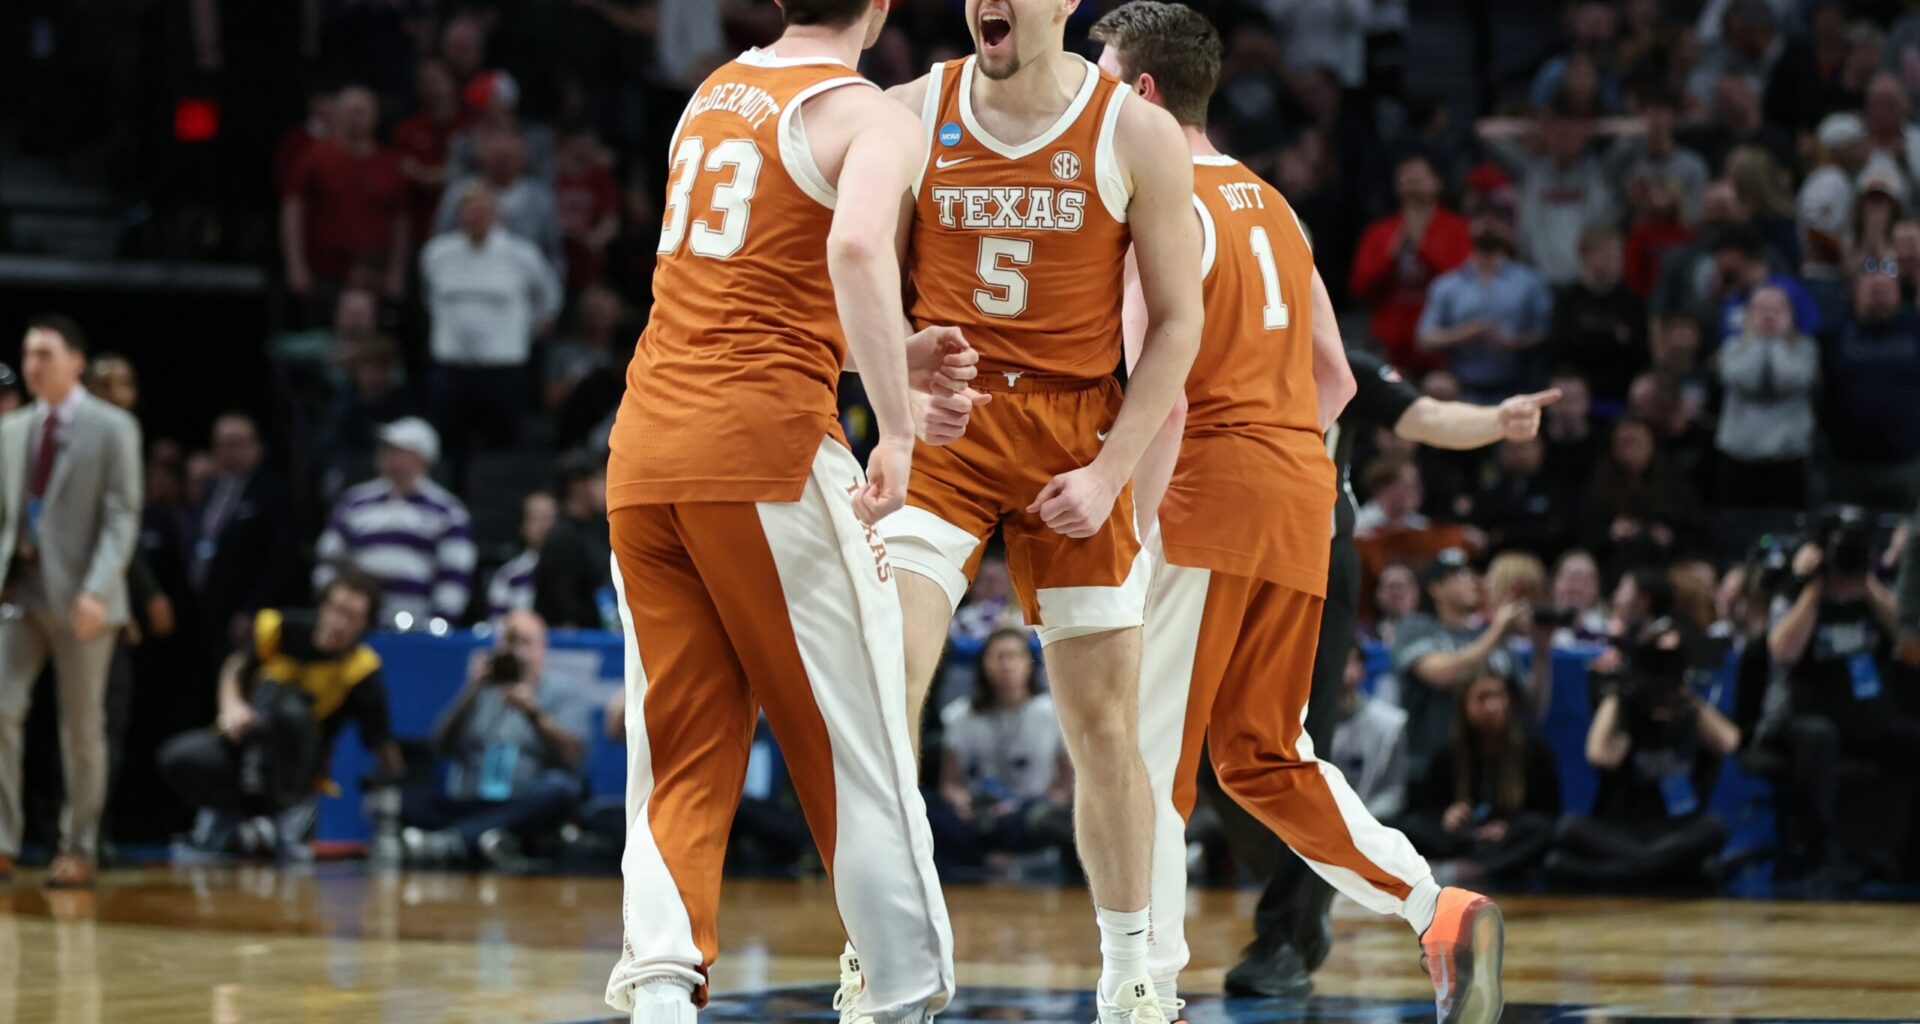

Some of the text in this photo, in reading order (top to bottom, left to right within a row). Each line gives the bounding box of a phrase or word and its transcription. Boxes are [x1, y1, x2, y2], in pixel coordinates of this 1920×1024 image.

[656, 136, 764, 261] 33
[1053, 153, 1079, 179] SEC
[1218, 182, 1264, 212] BOTT
[932, 187, 1086, 231] TEXAS
[973, 235, 1033, 318] 5
[1250, 226, 1289, 330] 1
[846, 475, 893, 583] TXAS
